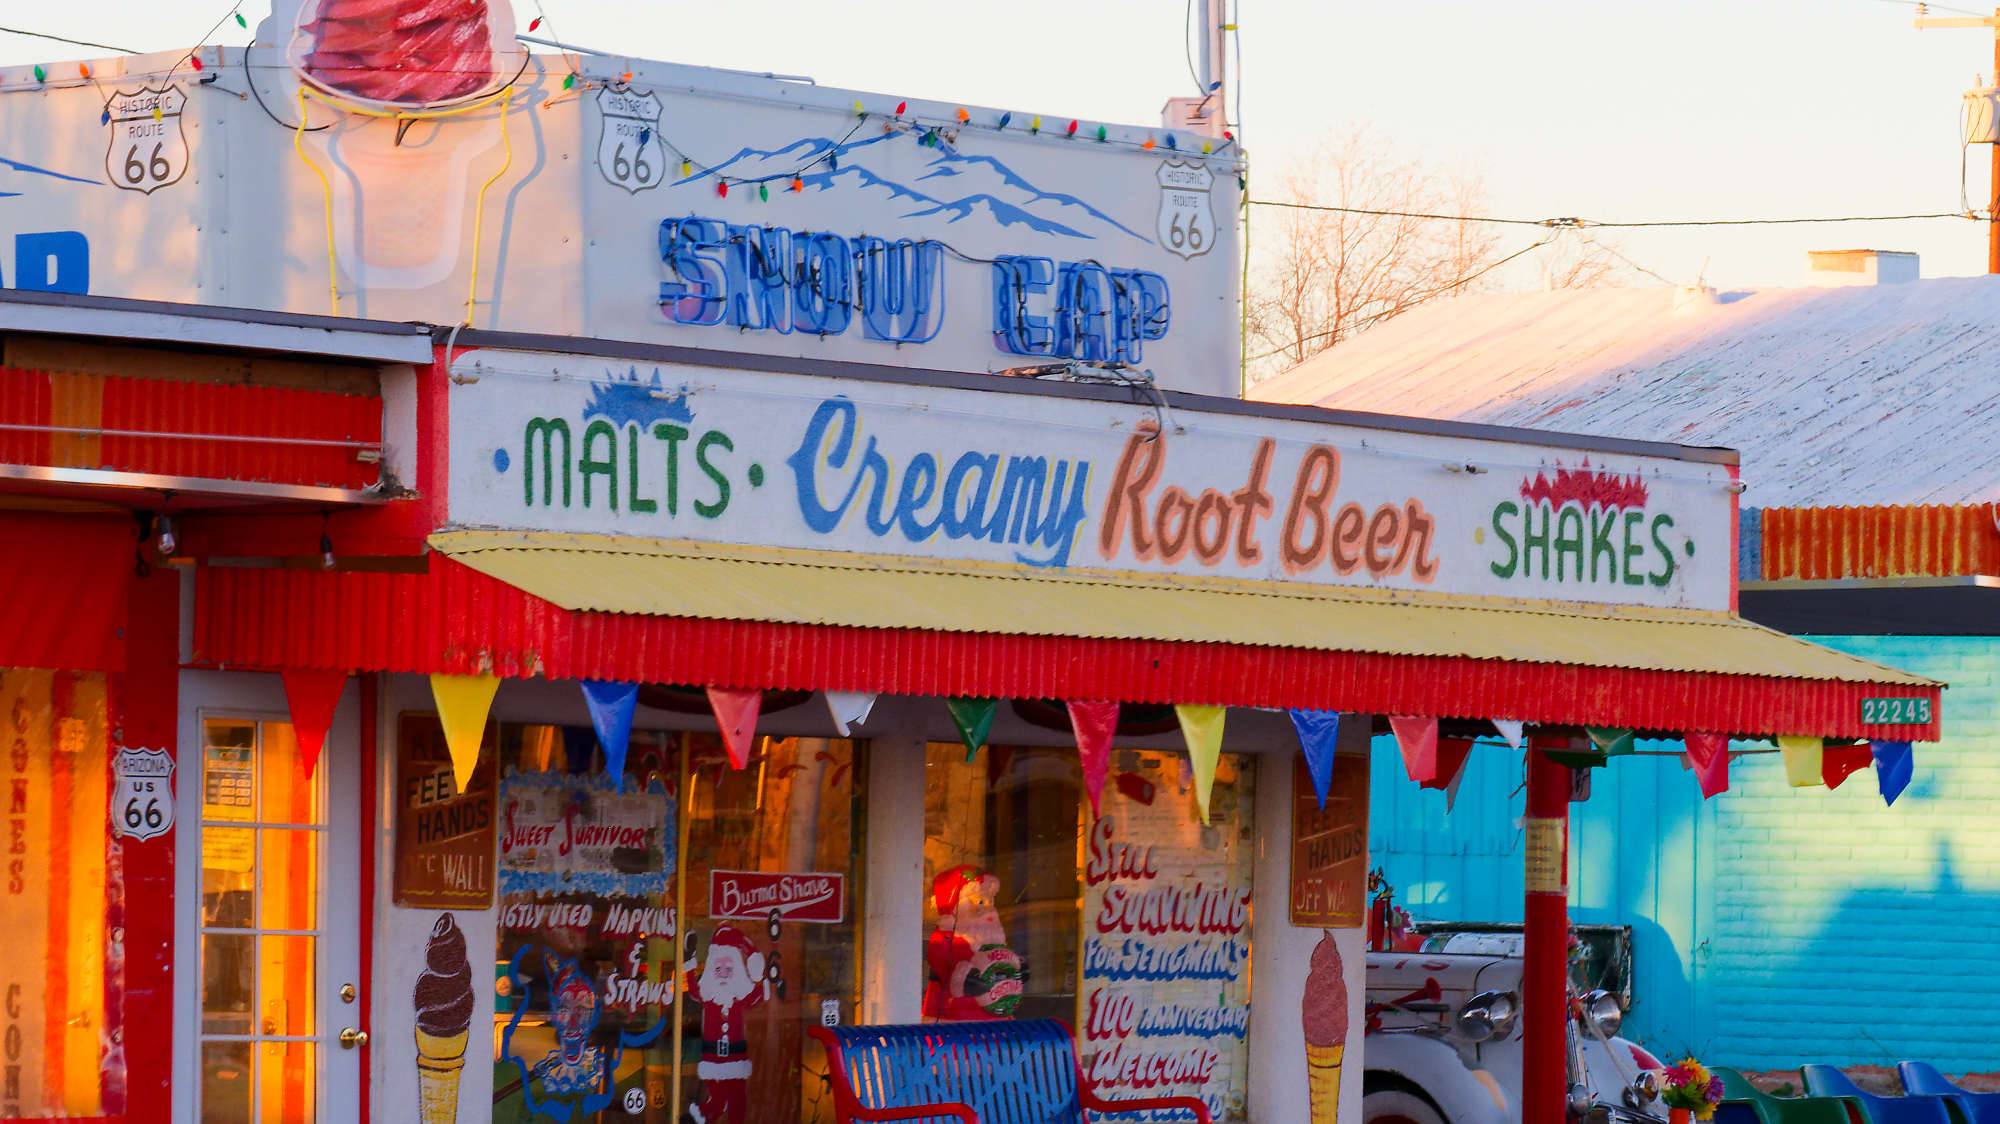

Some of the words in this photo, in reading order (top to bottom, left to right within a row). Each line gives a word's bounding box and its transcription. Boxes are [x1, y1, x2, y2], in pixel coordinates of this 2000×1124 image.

[128, 123, 165, 139] ROUTE
[124, 141, 170, 184] 66
[614, 141, 651, 184] 66
[1170, 212, 1203, 250] 66
[658, 216, 945, 344] SNOW
[991, 254, 1171, 364] CAP
[524, 416, 735, 520] MALTS
[786, 394, 1091, 568] Creamy
[1100, 420, 1276, 568] Root
[1279, 442, 1440, 584] Beer
[1490, 500, 1676, 588] SHAKES
[1864, 699, 1929, 722] 22245
[122, 758, 167, 773] ARIZONA
[133, 781, 155, 793] US
[125, 796, 162, 829] 66
[417, 800, 490, 846] HANDS
[559, 802, 647, 857] SURVIVOR
[720, 879, 777, 915] Burma
[779, 876, 834, 901] Shave
[1096, 882, 1251, 936] SURVIVING
[547, 902, 594, 929] USED
[603, 903, 677, 938] NAPKINS
[604, 972, 675, 1013] STRAWS
[1087, 1043, 1218, 1089] WELCOME
[627, 1092, 644, 1109] 66
